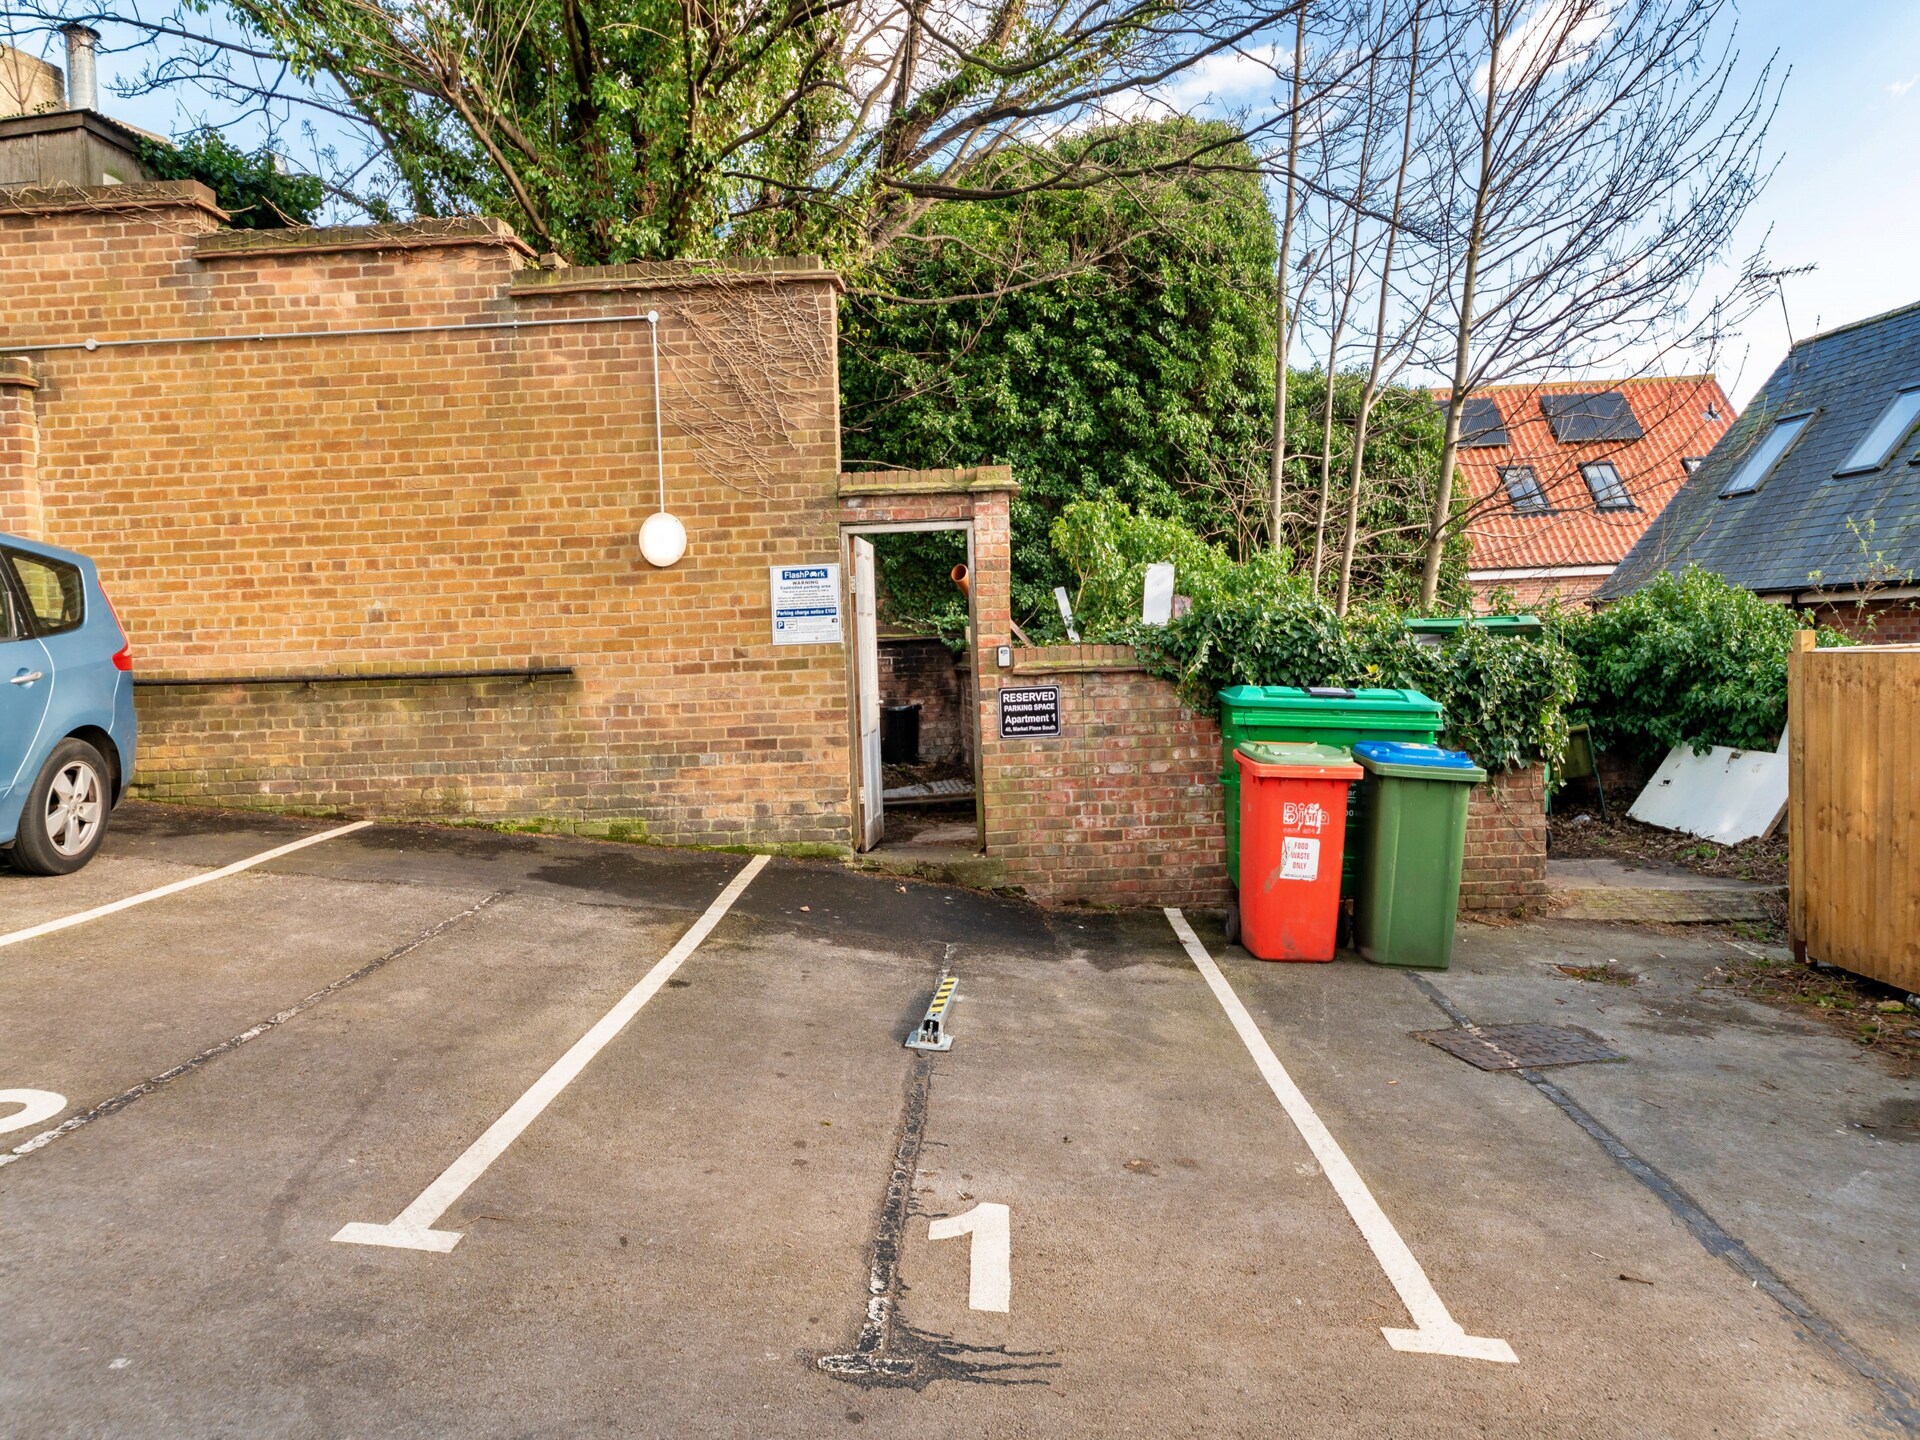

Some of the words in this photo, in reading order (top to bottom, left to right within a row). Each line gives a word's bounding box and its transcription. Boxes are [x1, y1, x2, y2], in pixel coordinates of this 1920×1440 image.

[1003, 691, 1056, 703] RESERVED
[1004, 704, 1033, 712] PARKING
[1033, 703, 1055, 711] SPACE
[1005, 713, 1050, 726] Apartment
[1051, 713, 1056, 722] 1
[1294, 841, 1309, 850] FOOD
[1291, 852, 1310, 860] WASTE
[1292, 861, 1307, 869] ONLY
[928, 1202, 1011, 1313] 1
